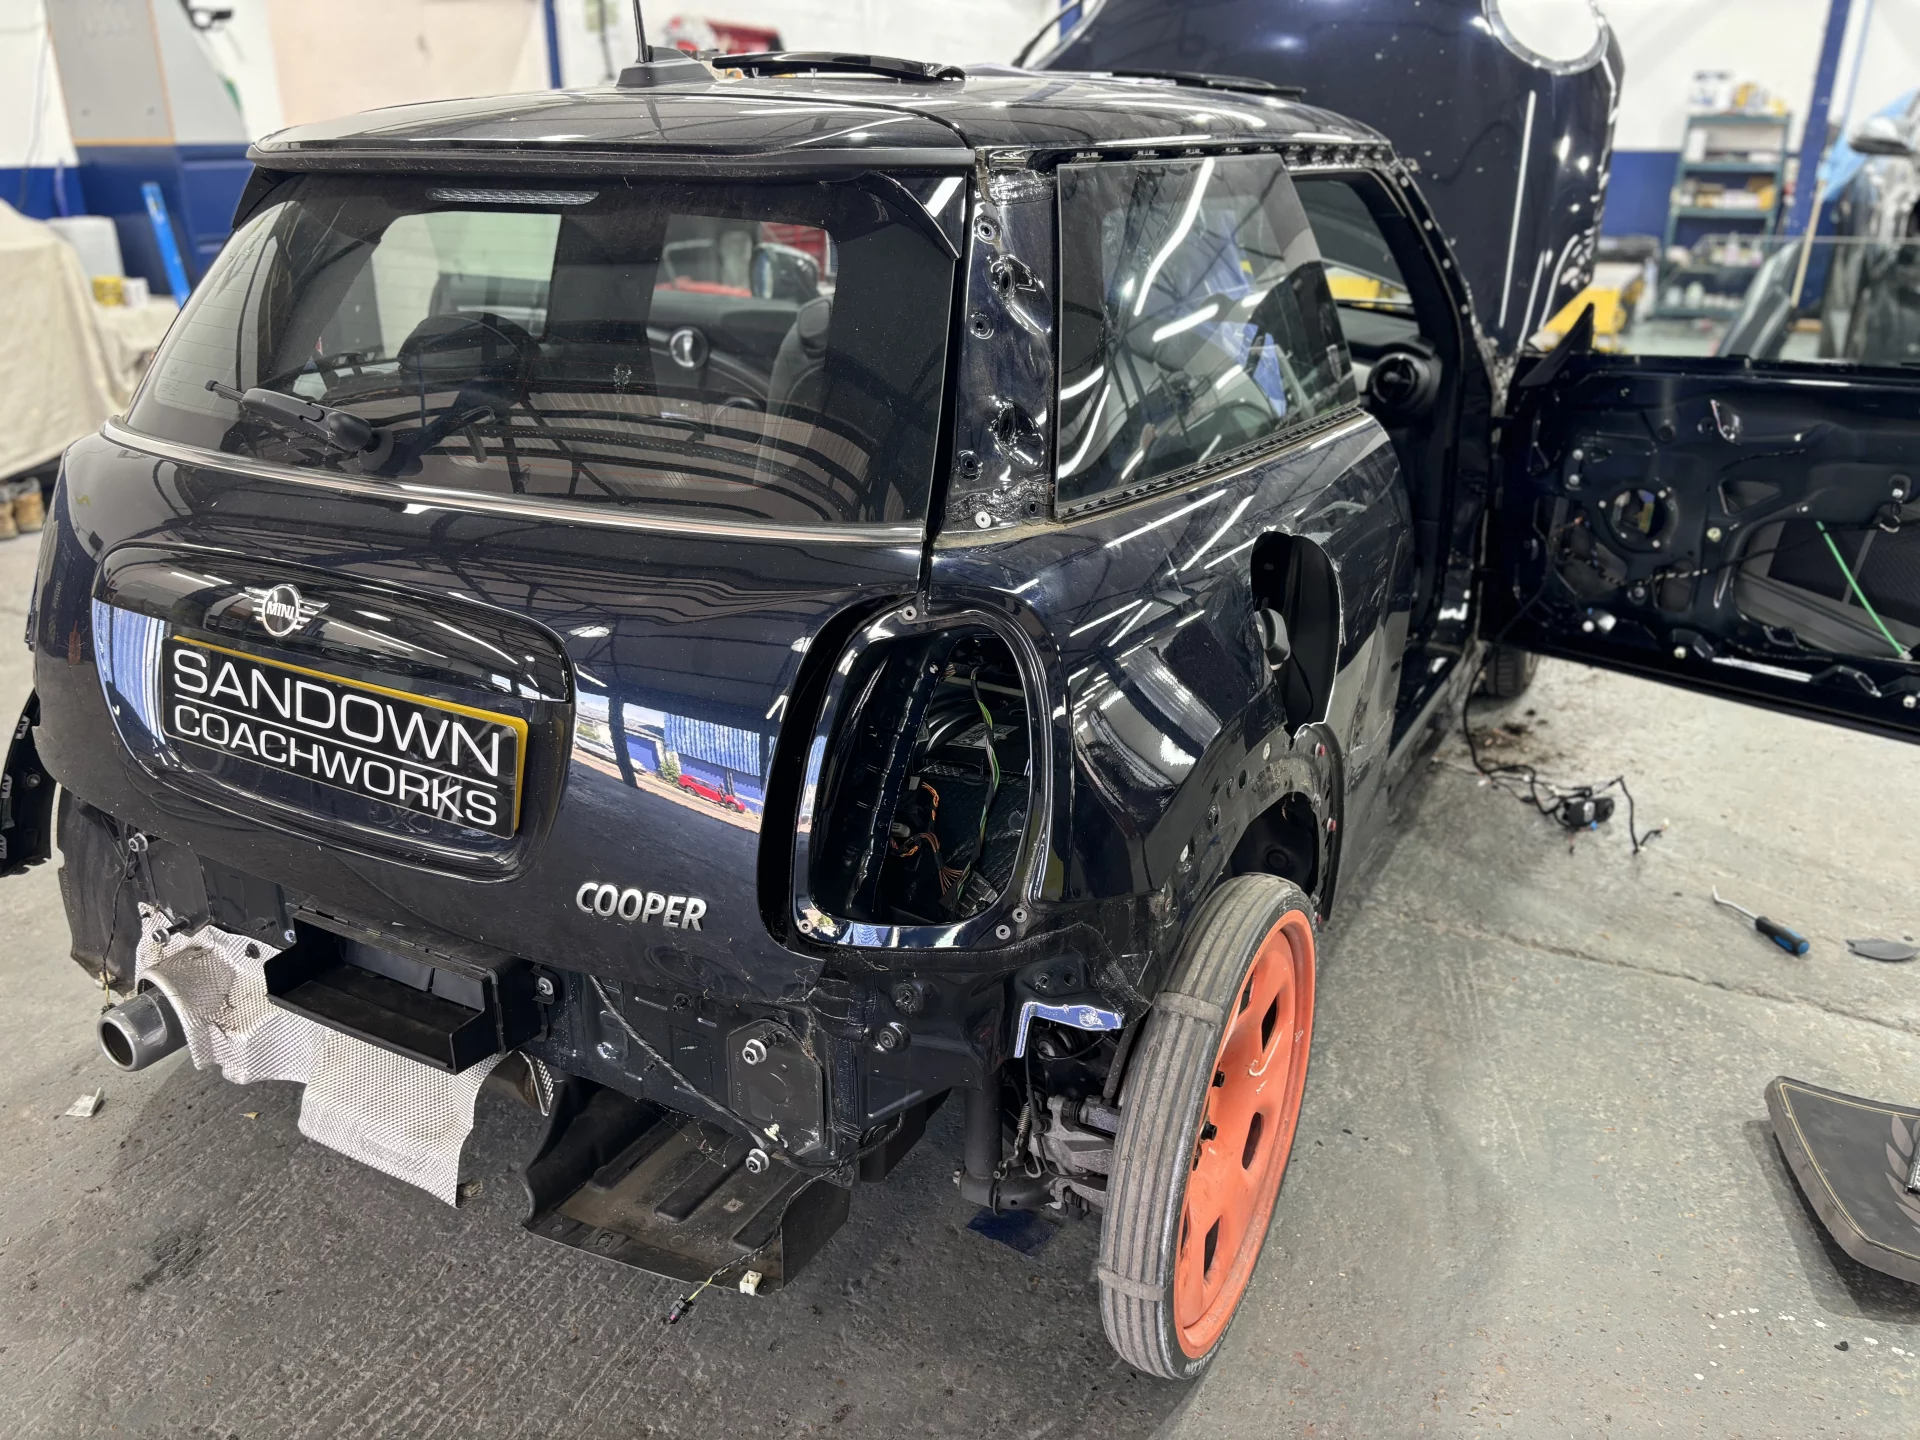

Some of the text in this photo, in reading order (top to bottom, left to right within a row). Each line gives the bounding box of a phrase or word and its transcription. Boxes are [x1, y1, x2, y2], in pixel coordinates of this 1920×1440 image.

[266, 600, 296, 621] MINI
[173, 649, 499, 777] SANDOWN
[174, 704, 498, 826] COACHWORKS
[576, 882, 707, 931] COOPER
